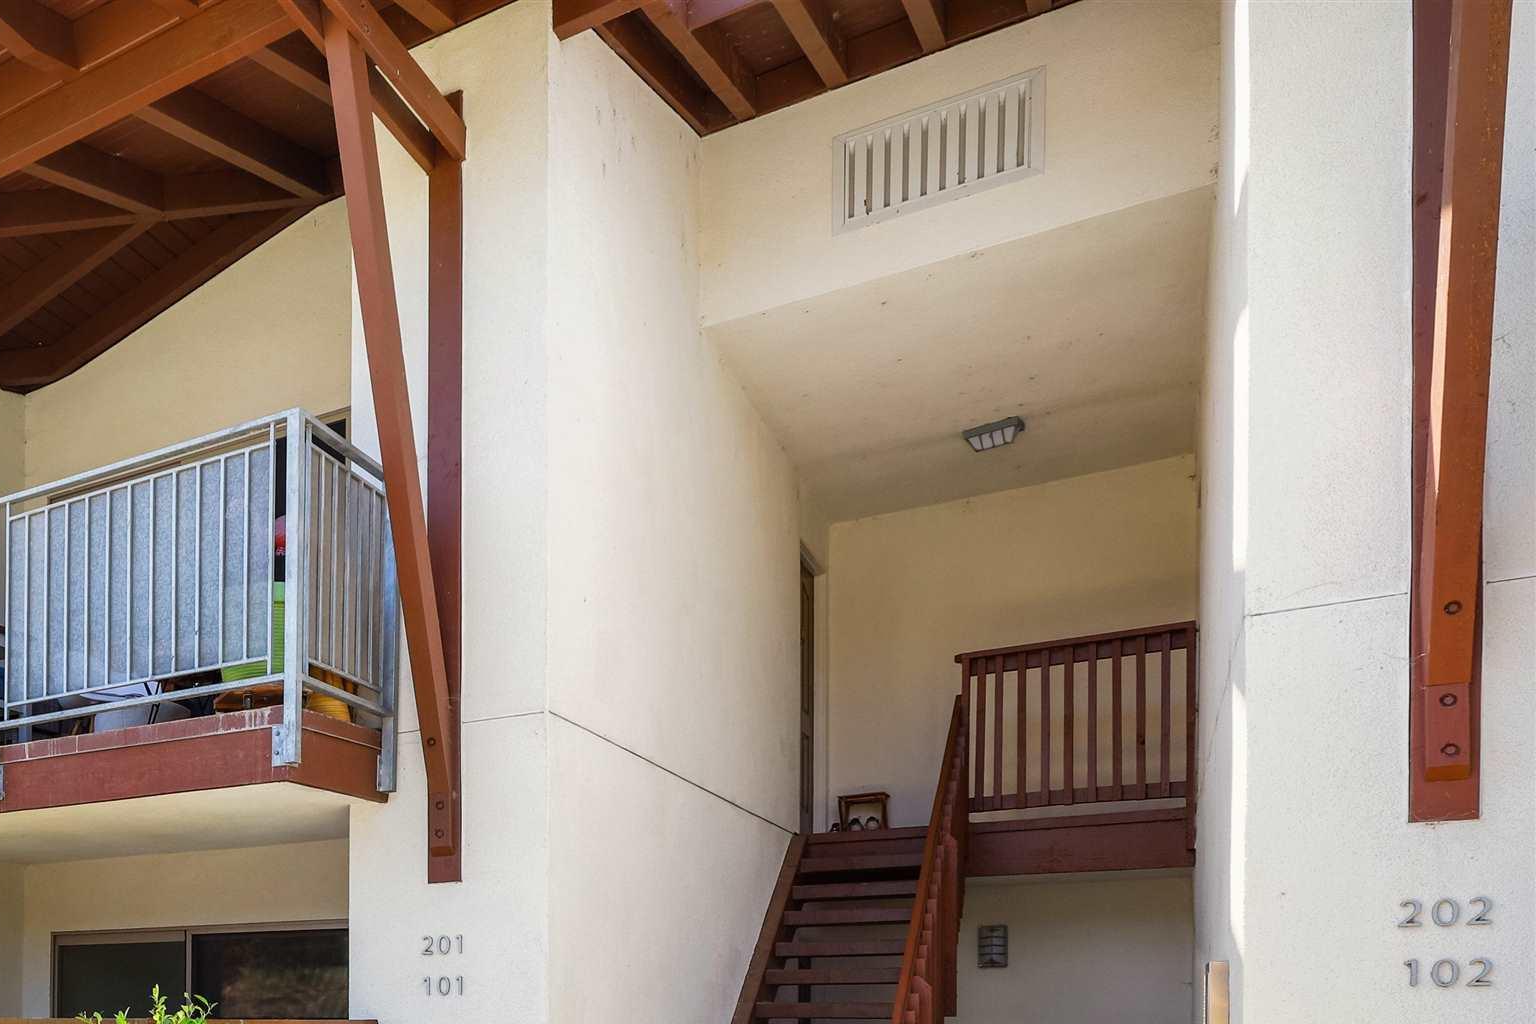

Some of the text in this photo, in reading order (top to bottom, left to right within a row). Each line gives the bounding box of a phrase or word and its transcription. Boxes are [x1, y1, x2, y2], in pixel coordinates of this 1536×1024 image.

[1397, 896, 1493, 928] 202
[422, 934, 463, 955] 201
[423, 975, 463, 996] 101
[1404, 958, 1493, 988] 102
